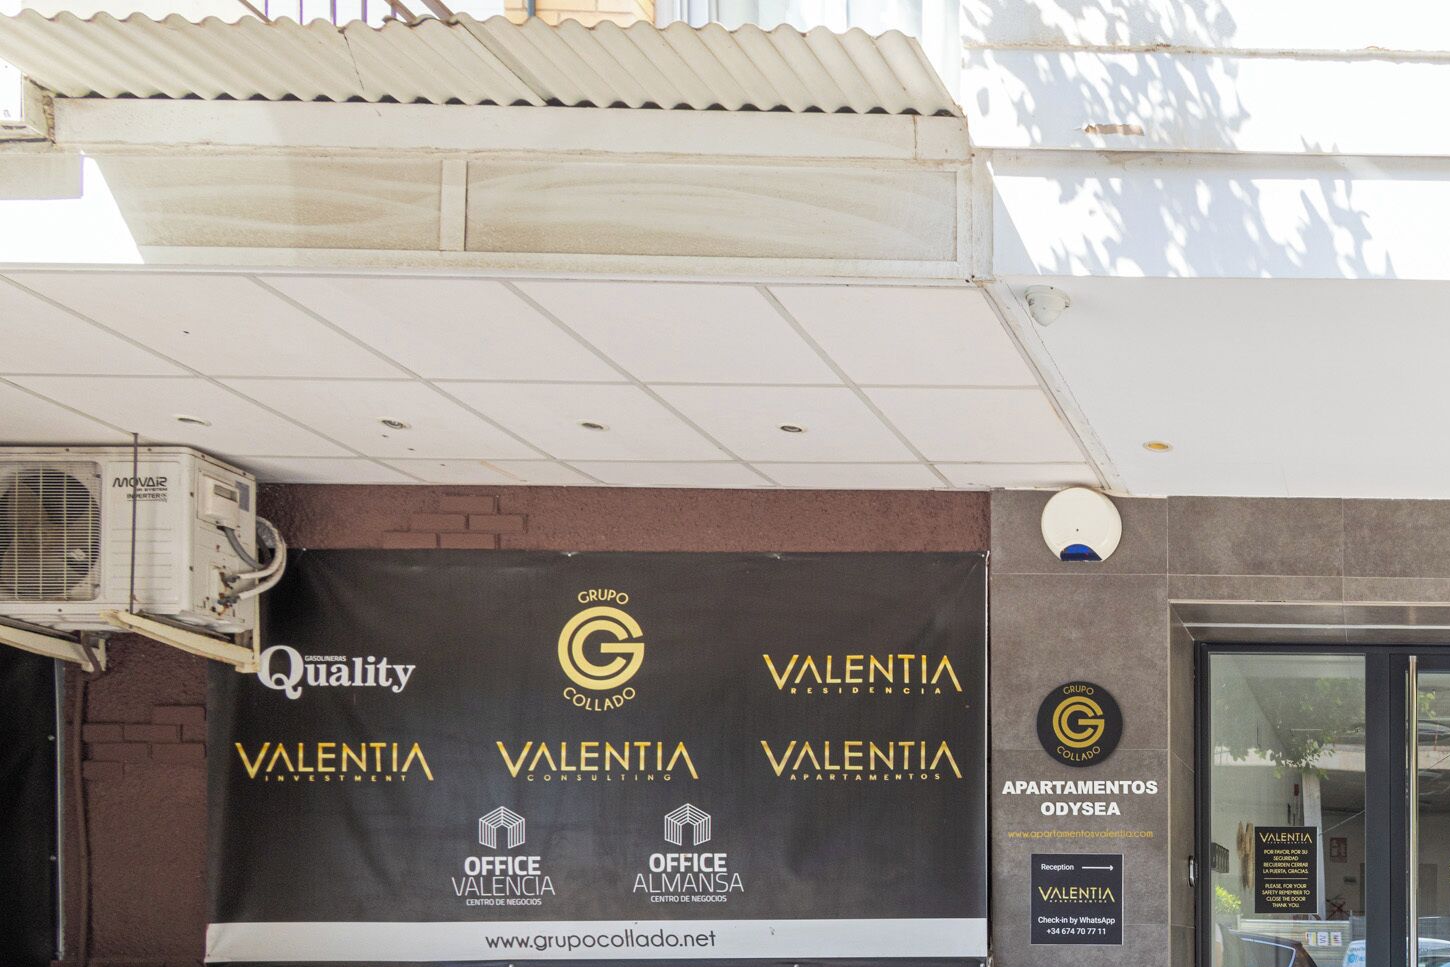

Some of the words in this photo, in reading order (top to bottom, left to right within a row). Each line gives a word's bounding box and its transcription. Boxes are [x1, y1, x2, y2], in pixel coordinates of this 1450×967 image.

[578, 588, 629, 605] GRUPO
[257, 645, 416, 700] Quality
[762, 654, 963, 692] VALENTIA
[791, 687, 941, 695] RESIDENCIA
[1063, 685, 1094, 695] GRUPO
[563, 687, 635, 711] COLLADO
[235, 742, 434, 781] VALENTIA
[496, 741, 699, 780] VALENTIA
[760, 740, 963, 779] VALENTIA
[1057, 746, 1100, 761] COLLADO
[527, 774, 671, 782] CONSULTING
[790, 773, 940, 781] APARTAMENTOS
[1002, 781, 1158, 795] APARTAMENTOS
[1040, 801, 1121, 816] ODYSEA
[1008, 829, 1153, 838] www.apartamentosvalentia.com
[1259, 832, 1312, 843] VALENTIA
[464, 856, 541, 876] OFFICE
[649, 853, 727, 873] OFFICE
[451, 875, 556, 896] VALENCIA
[632, 872, 744, 893] ALMANSA
[506, 898, 542, 906] NEGOCIOS
[650, 895, 679, 903] CENTRO
[1038, 886, 1115, 902] VALENTIA
[1070, 917, 1078, 925] by
[1079, 917, 1115, 925] WhatsApp
[485, 929, 716, 951] www.grupocollado.net
